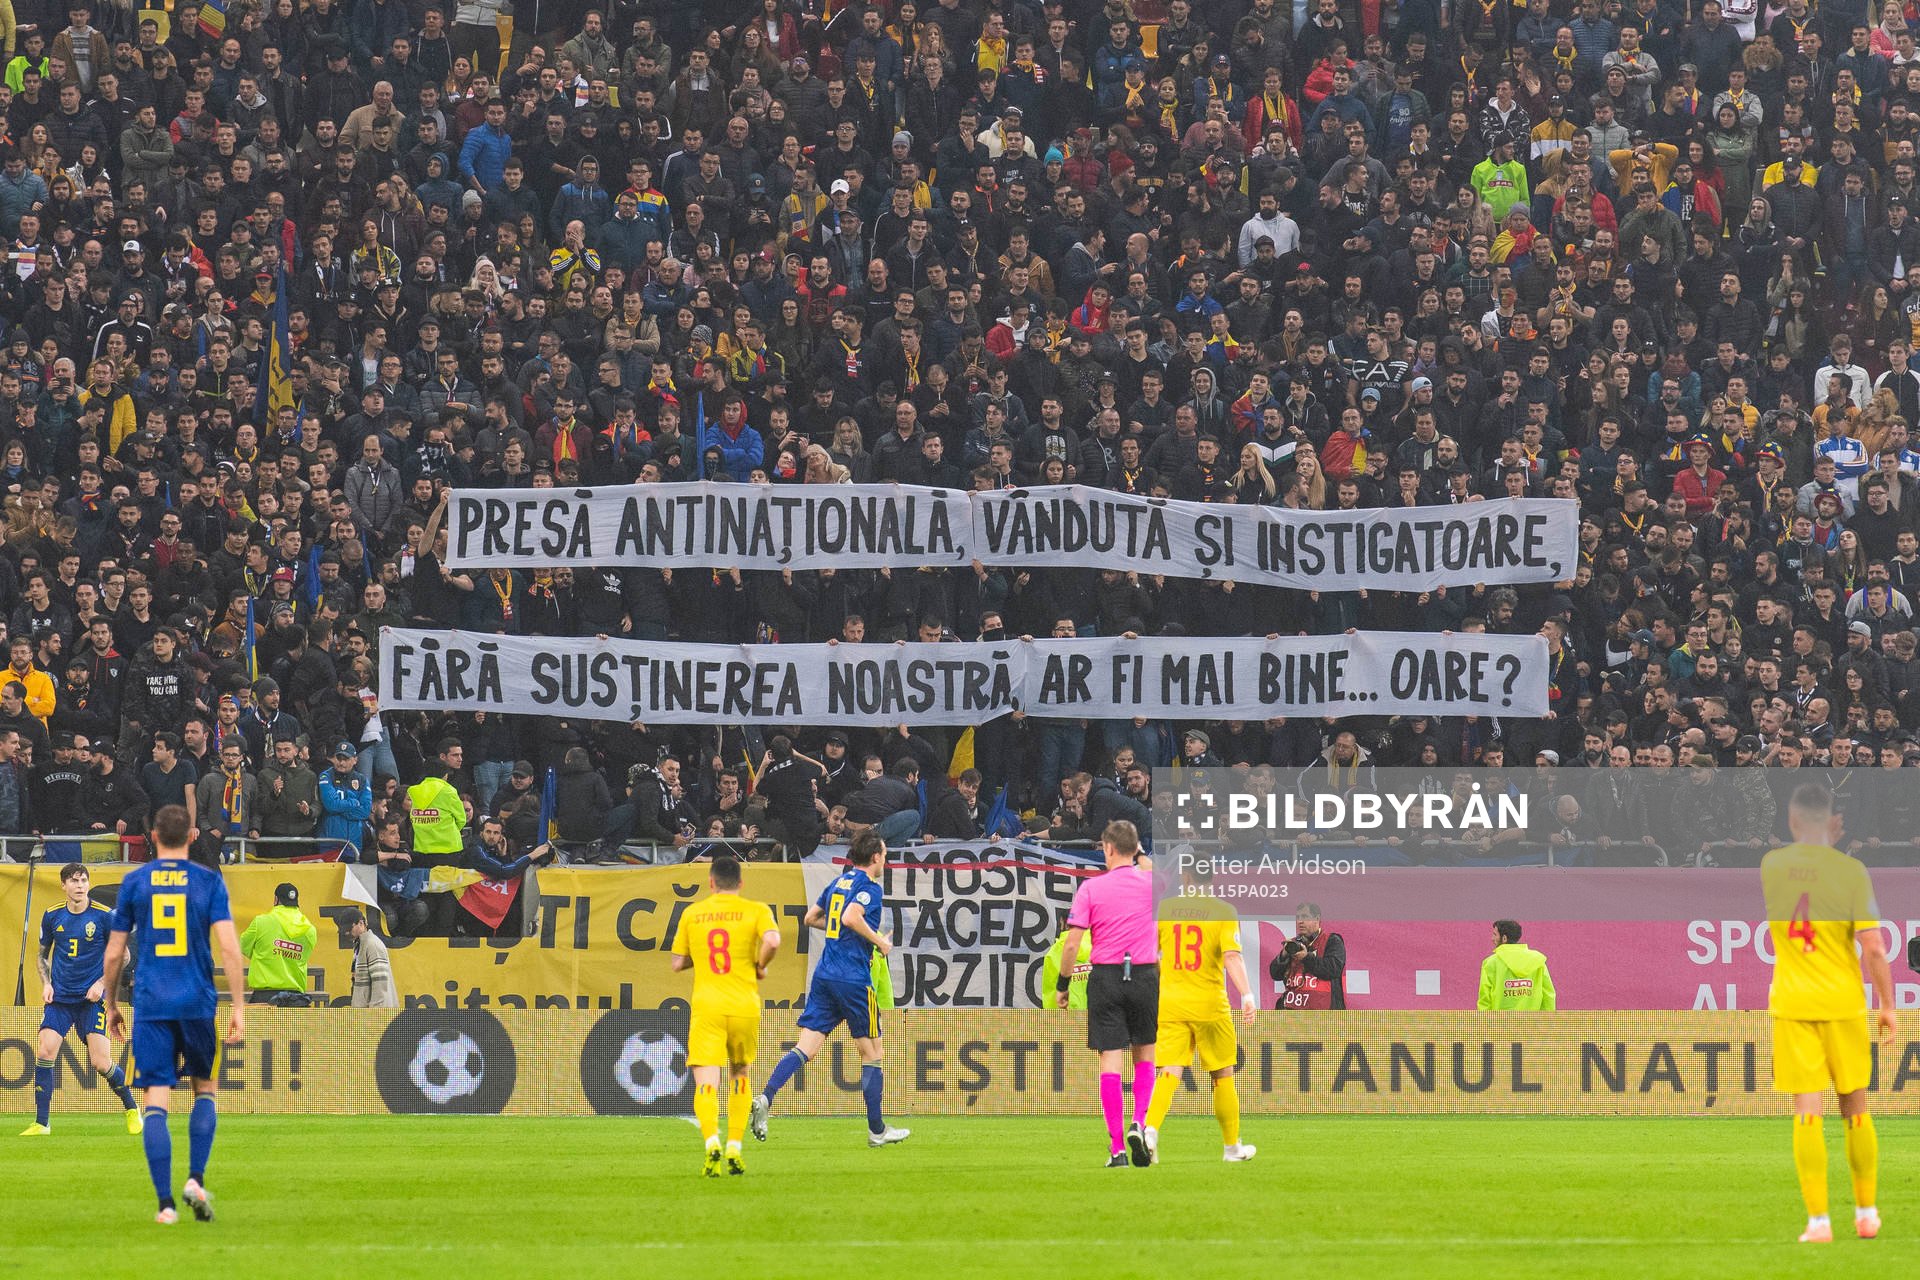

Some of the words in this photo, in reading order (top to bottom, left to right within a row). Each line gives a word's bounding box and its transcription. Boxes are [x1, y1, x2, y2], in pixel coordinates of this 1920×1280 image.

[457, 489, 593, 557] PRESĂ
[615, 490, 965, 564] ANTINAȚIONALĂ,
[1194, 514, 1234, 578] ȘI
[1257, 514, 1562, 576] INSTIGATOARE,
[393, 637, 503, 703] FĂRĂ
[531, 652, 804, 721] SUSȚINEREA
[1039, 653, 1093, 704] AR
[1112, 653, 1144, 704] FI
[1161, 651, 1234, 705] MAI
[1259, 650, 1378, 704] BINE...
[151, 870, 188, 886] BERG
[152, 893, 188, 957] 9
[694, 912, 743, 924] STANCIU
[826, 893, 845, 939] 8
[1788, 892, 1818, 954] 4
[68, 938, 78, 957] 3
[708, 929, 731, 974] 8
[1173, 923, 1203, 972] 13
[95, 1012, 105, 1030] 3
[915, 1041, 1064, 1107] EȘTI
